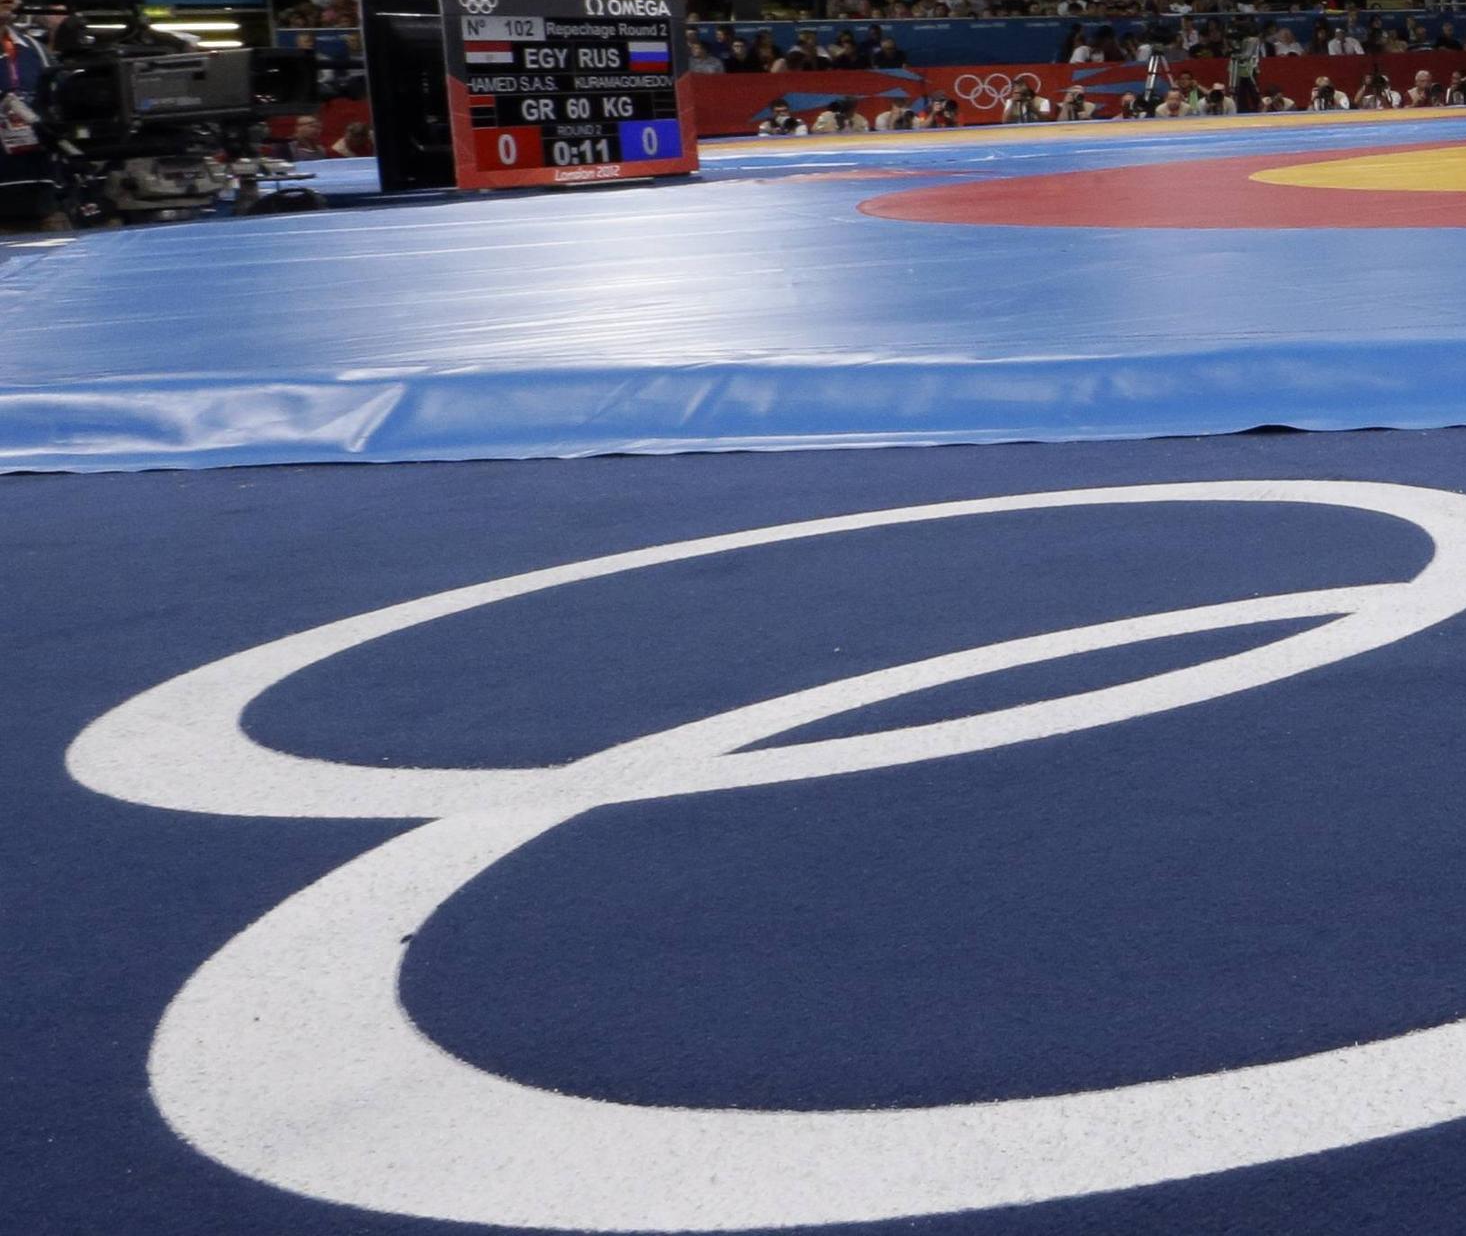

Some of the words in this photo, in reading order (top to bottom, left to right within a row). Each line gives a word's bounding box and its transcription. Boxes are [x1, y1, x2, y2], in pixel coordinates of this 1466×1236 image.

[607, 0, 671, 16] OMEGA
[505, 20, 534, 36] 102
[547, 24, 616, 39] Repechage
[619, 24, 658, 36] Round
[660, 24, 667, 36] 2
[524, 49, 568, 68] EGY
[579, 49, 620, 68] RUS
[520, 77, 559, 92] S.A.S.
[521, 100, 555, 120] GR
[566, 99, 589, 118] 60
[603, 97, 633, 117] KG
[557, 126, 593, 136] ROUND
[498, 134, 517, 164] 0
[642, 127, 658, 155] 0
[553, 139, 609, 165] 0:11
[555, 167, 595, 181] London
[597, 165, 620, 178] 2012
